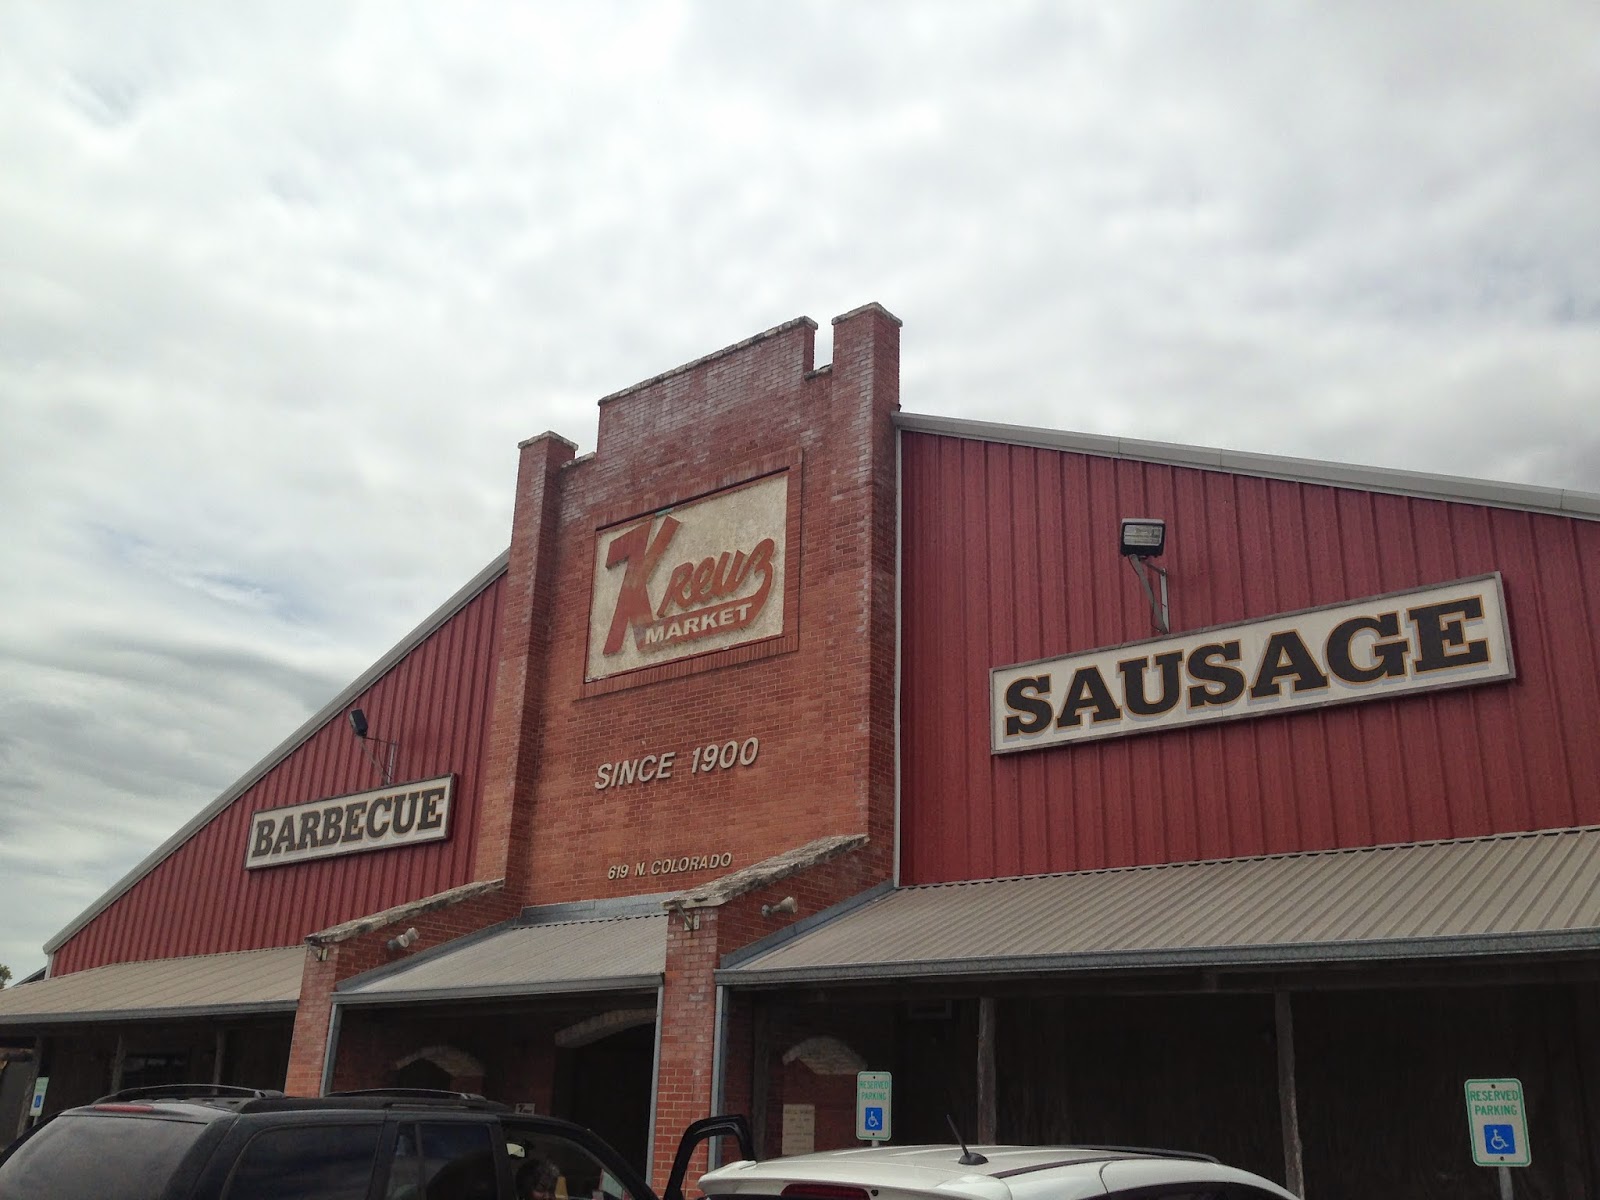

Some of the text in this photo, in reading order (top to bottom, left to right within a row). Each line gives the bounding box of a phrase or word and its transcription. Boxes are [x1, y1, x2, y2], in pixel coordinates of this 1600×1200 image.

[644, 603, 753, 645] MARKET
[1004, 594, 1492, 737] SAUSAGE
[594, 737, 759, 790] SINCE 1900
[251, 785, 447, 858] BARBECUE
[607, 852, 733, 880] 619 N. COLORADO
[859, 1080, 889, 1090] RESERVED
[861, 1092, 887, 1101] PARKING
[1469, 1090, 1519, 1102] RESERVED
[1475, 1105, 1518, 1116] PARKING
